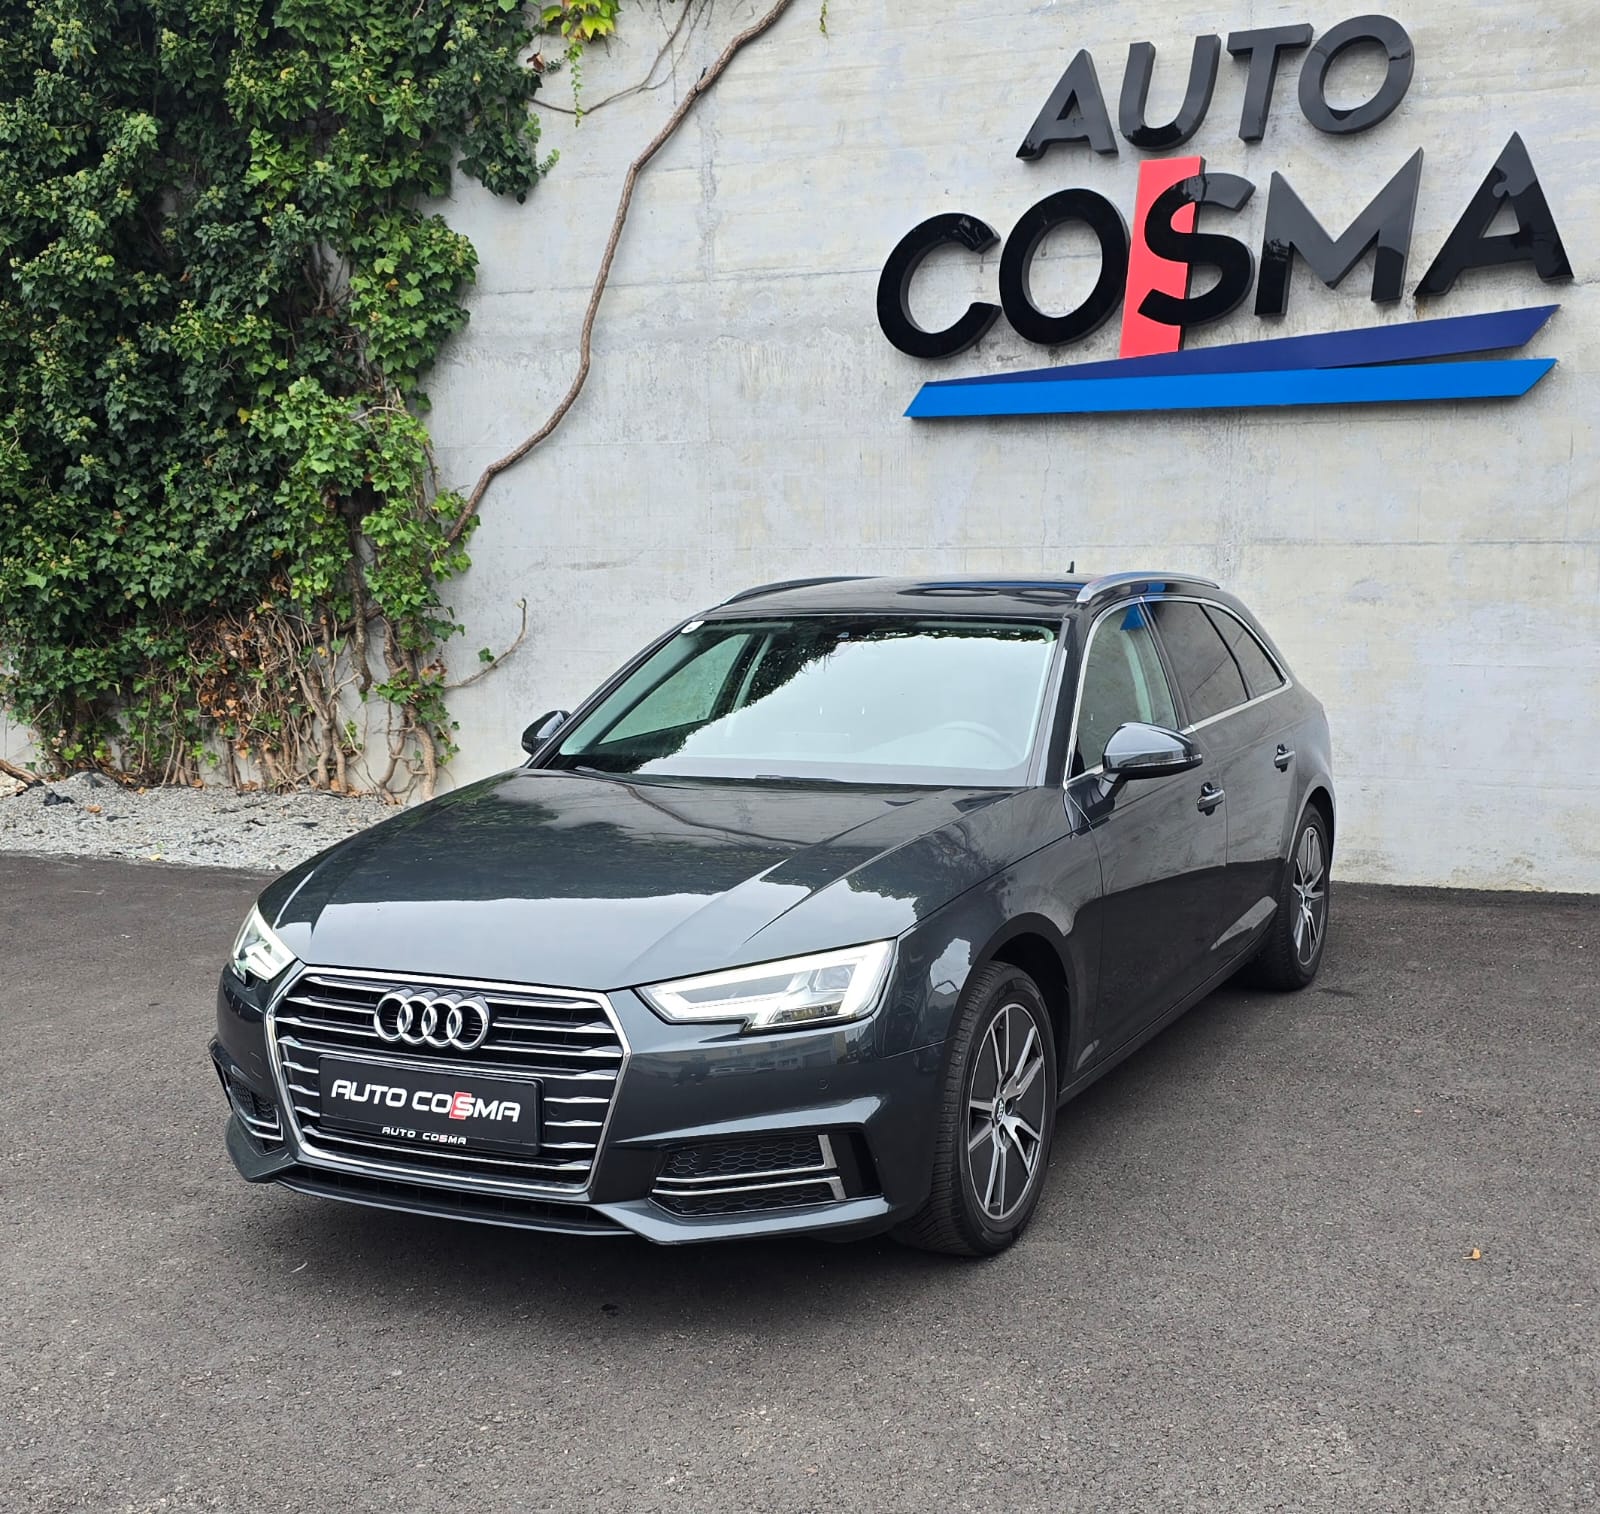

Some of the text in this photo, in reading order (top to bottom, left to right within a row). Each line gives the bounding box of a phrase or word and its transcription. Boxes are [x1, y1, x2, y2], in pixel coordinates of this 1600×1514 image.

[1016, 14, 1414, 161] AUTO
[876, 131, 1574, 360] COSMA
[331, 1079, 521, 1122] AUTO COSMA
[381, 1126, 467, 1146] AUTO COSMA
